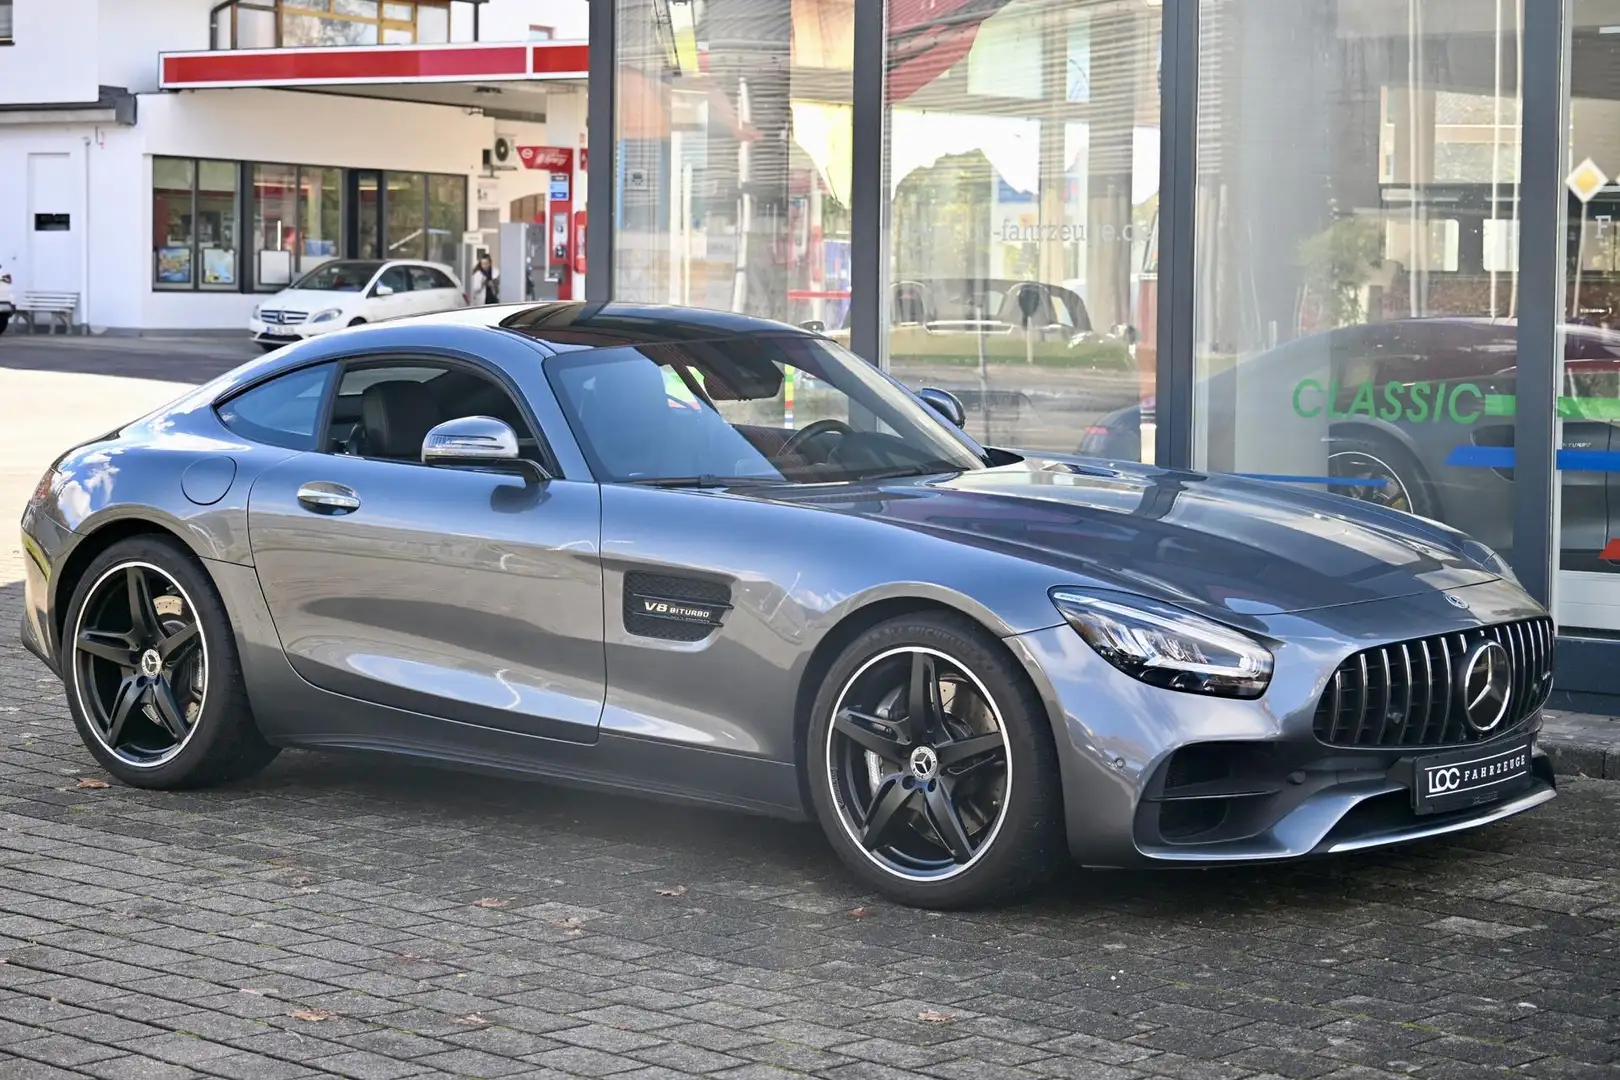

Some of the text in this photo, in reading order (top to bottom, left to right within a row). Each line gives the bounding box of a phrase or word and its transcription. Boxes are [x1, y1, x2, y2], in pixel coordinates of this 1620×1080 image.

[1292, 378, 1482, 424] CLASSIC
[644, 601, 710, 618] V8 BITURBO
[1428, 754, 1526, 793] LOC FAHRZEUGE
